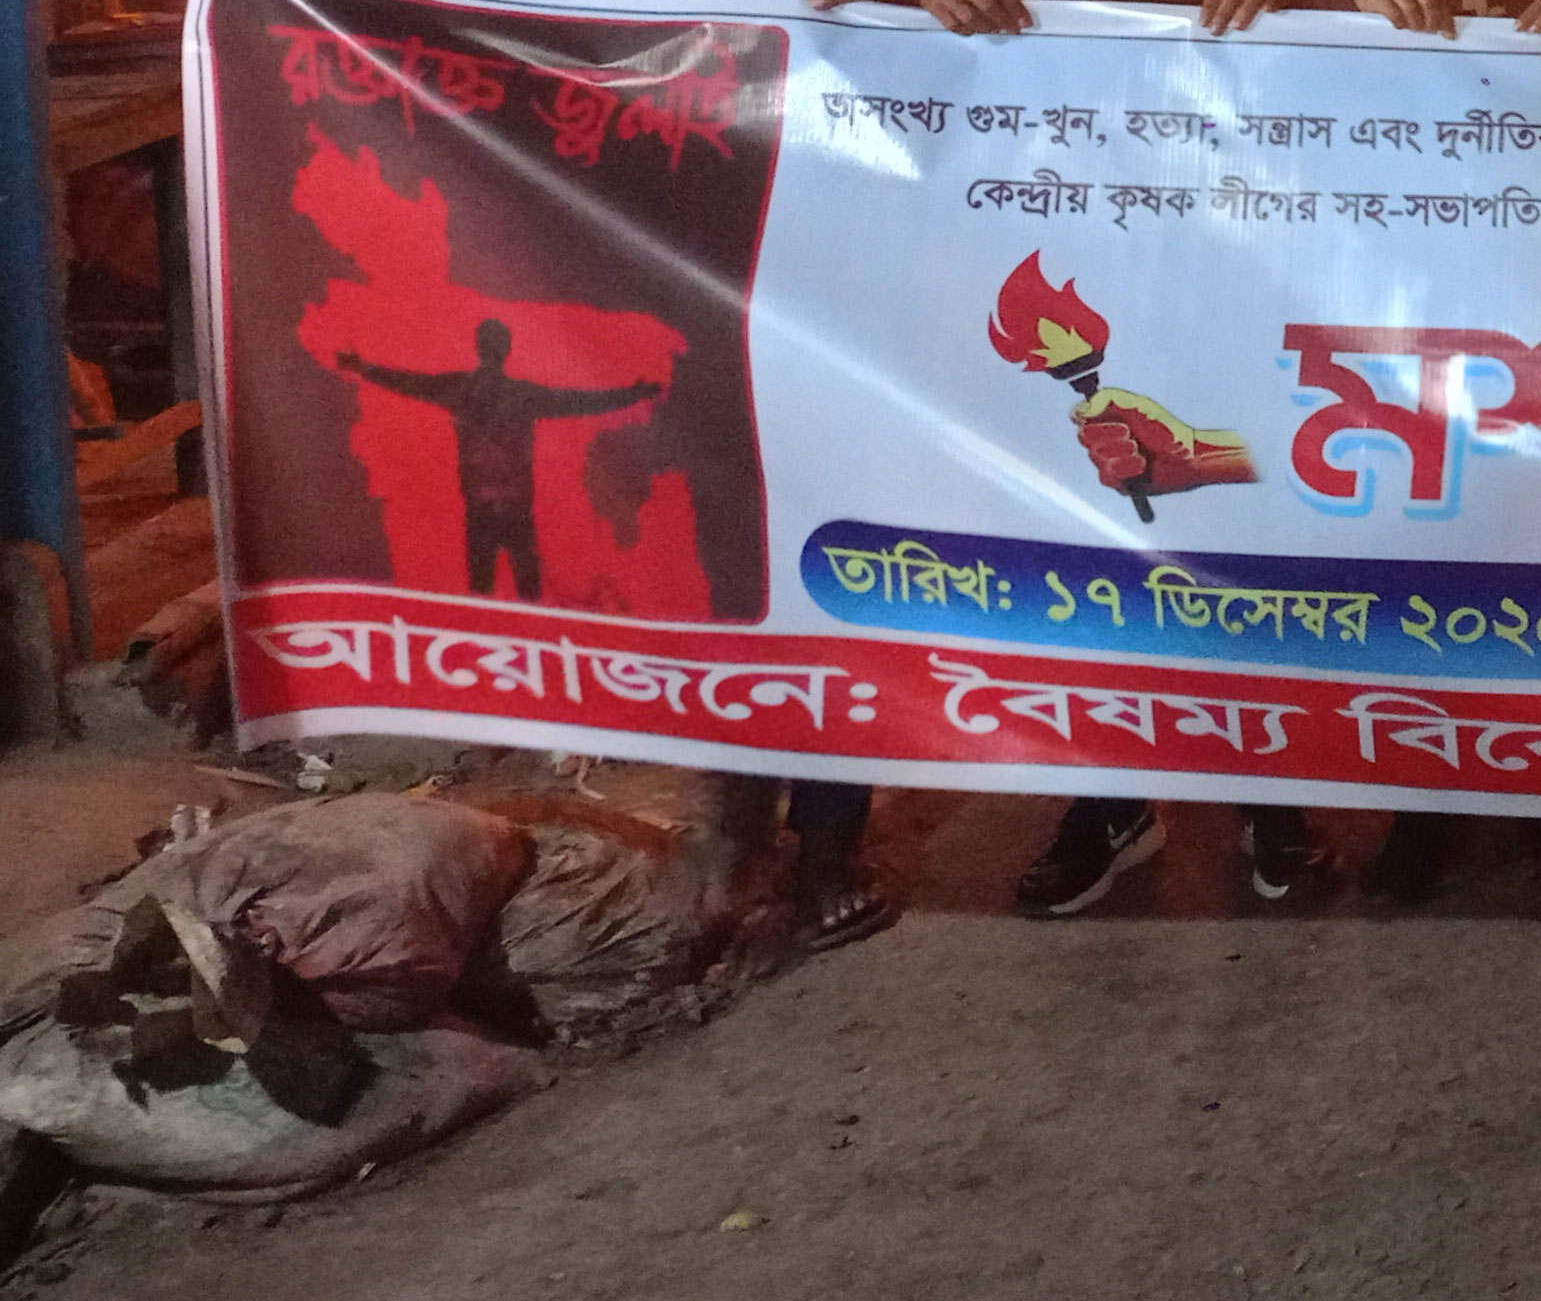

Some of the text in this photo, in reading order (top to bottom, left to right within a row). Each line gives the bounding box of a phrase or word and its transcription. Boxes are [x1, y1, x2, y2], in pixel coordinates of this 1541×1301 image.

[966, 104, 1107, 148] গুম-খুন,
[1236, 113, 1337, 149] সন্ত্রাস
[1349, 119, 1422, 153] এবং
[966, 168, 1093, 218] কেন্দ্রীয়
[1104, 184, 1199, 230] কৃষক
[1044, 570, 1126, 626] ১৭
[1144, 566, 1380, 642] ডিসেম্বর
[926, 650, 1312, 756] বৈষম্য
